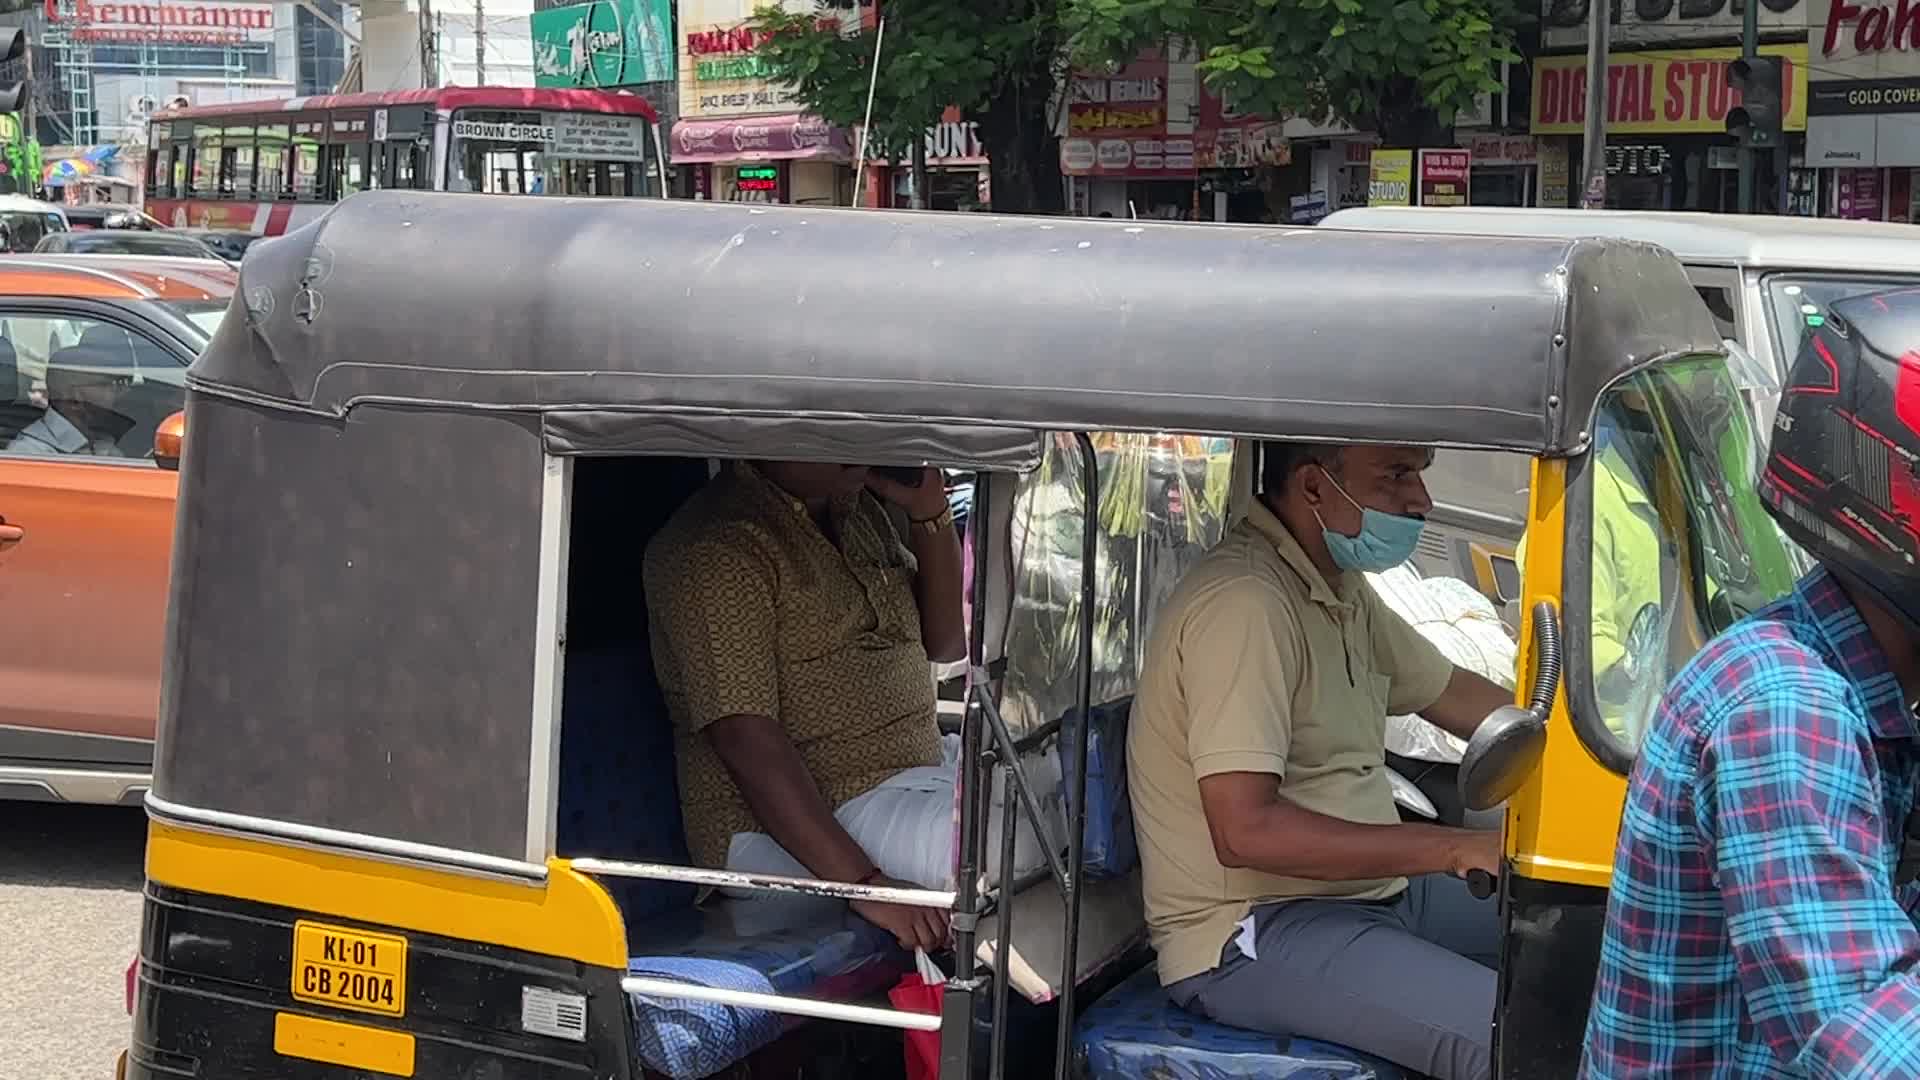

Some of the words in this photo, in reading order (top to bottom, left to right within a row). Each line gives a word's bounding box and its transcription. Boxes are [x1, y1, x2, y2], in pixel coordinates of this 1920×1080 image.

[1537, 63, 1656, 125] DIGTAL
[1848, 90, 1881, 105] GOLD
[455, 124, 505, 138] BROWN
[509, 126, 554, 141] CIRCLE
[1368, 182, 1408, 201] STUDIO
[303, 966, 331, 995] CB
[338, 972, 394, 1005] 2004
